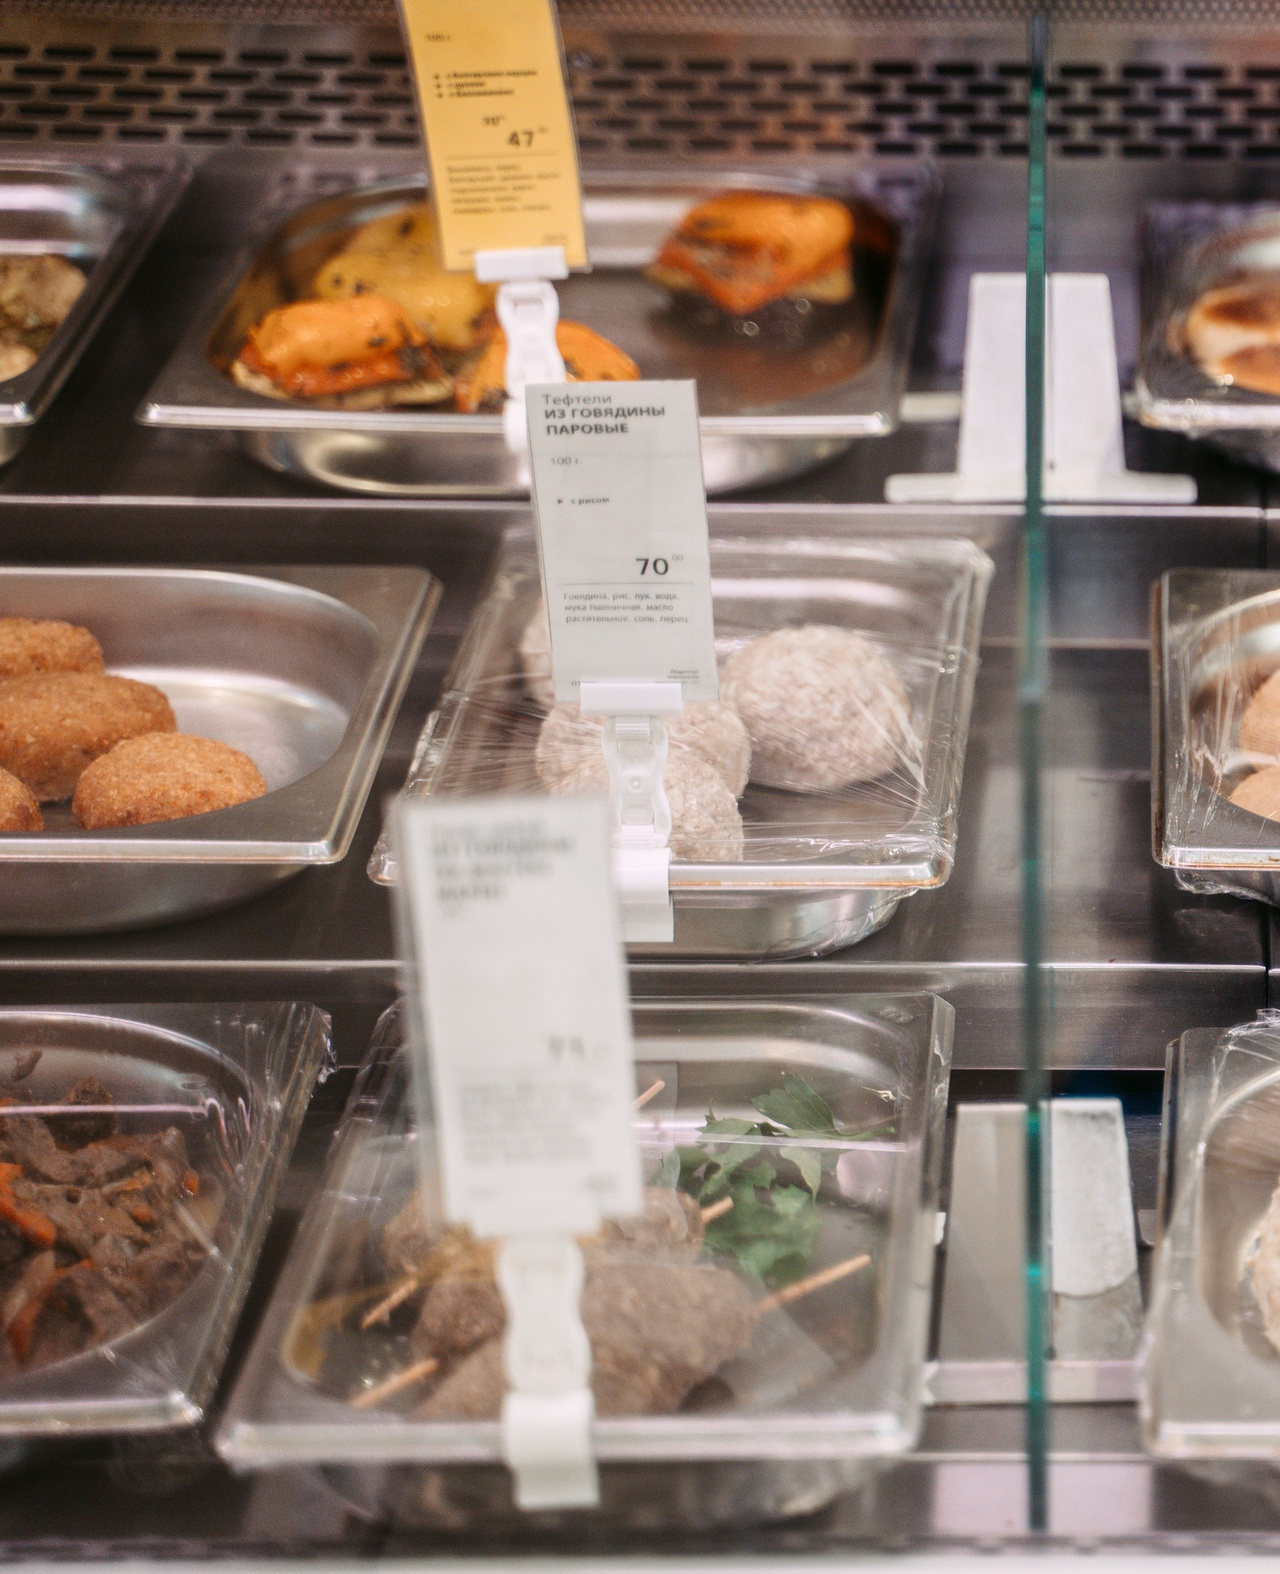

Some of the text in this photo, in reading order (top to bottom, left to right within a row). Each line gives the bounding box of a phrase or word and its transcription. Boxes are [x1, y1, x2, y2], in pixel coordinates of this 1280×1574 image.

[507, 131, 534, 147] 47
[542, 394, 612, 407] Тефтели
[545, 407, 665, 419] ИЗ ГОВЯДИНЫ
[546, 423, 629, 435] ПАРОВЫЕ
[551, 457, 572, 465] 100
[578, 497, 610, 505] рисом
[636, 558, 669, 575] 70
[613, 593, 631, 601] рис,
[565, 604, 586, 613] мука
